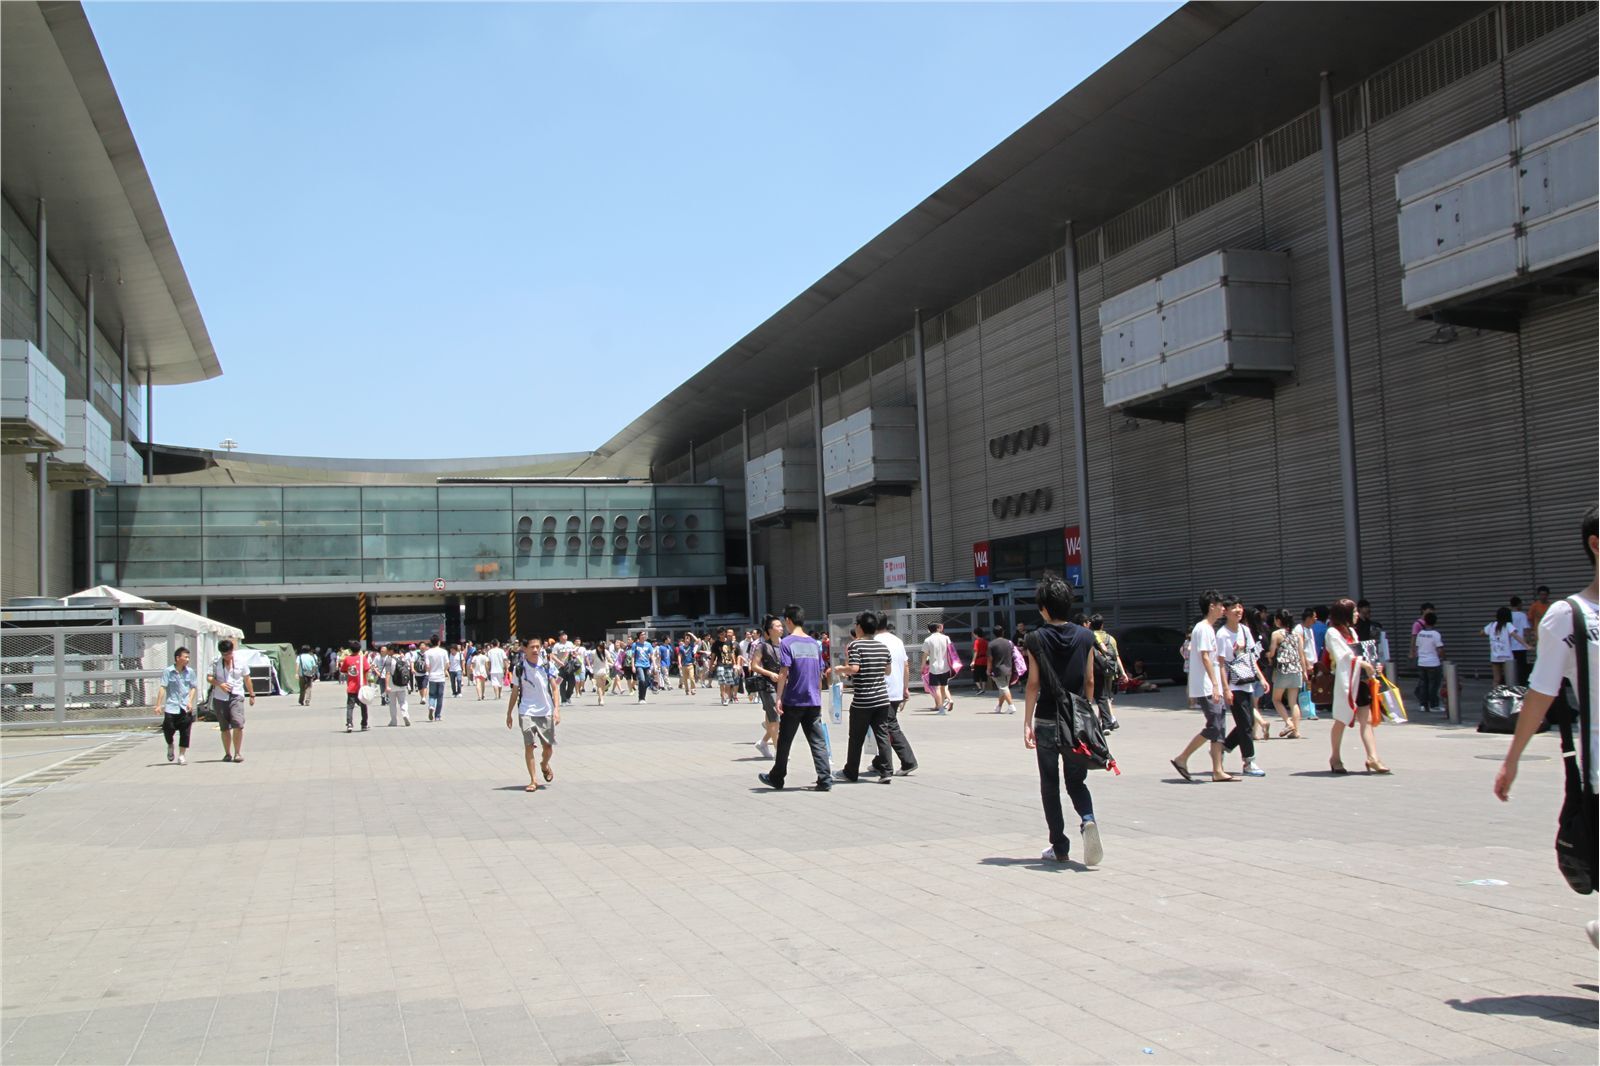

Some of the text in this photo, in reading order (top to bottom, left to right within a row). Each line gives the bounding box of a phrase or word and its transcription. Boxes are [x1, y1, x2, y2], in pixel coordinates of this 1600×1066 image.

[1066, 537, 1080, 556] W4
[974, 552, 988, 567] W4
[1072, 574, 1079, 586] 7
